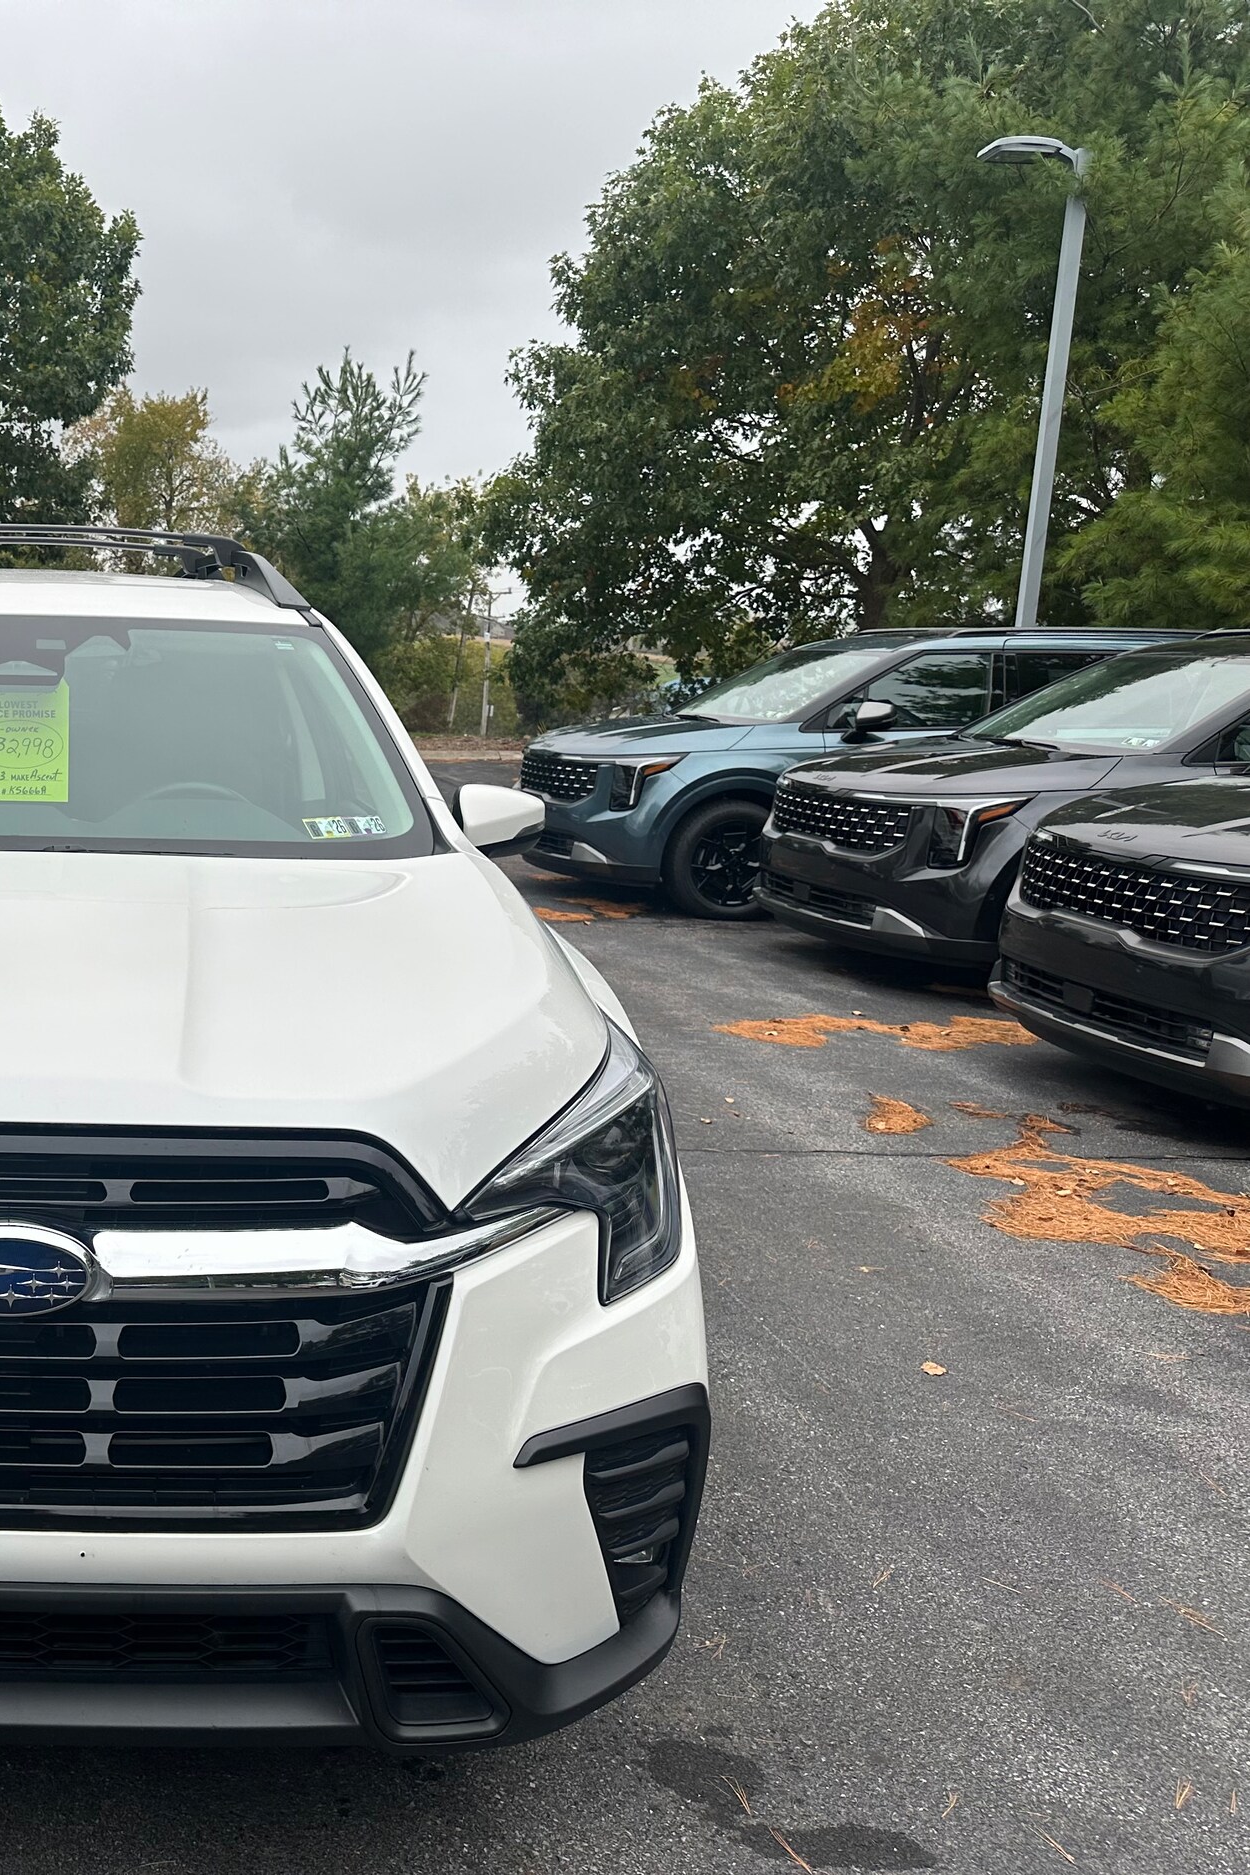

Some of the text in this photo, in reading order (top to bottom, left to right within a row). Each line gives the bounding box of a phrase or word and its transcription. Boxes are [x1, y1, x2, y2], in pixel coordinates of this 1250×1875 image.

[12, 710, 56, 718] PROMISE
[30, 769, 63, 781] Ascent
[332, 819, 347, 834] 26
[370, 817, 386, 832] 26
